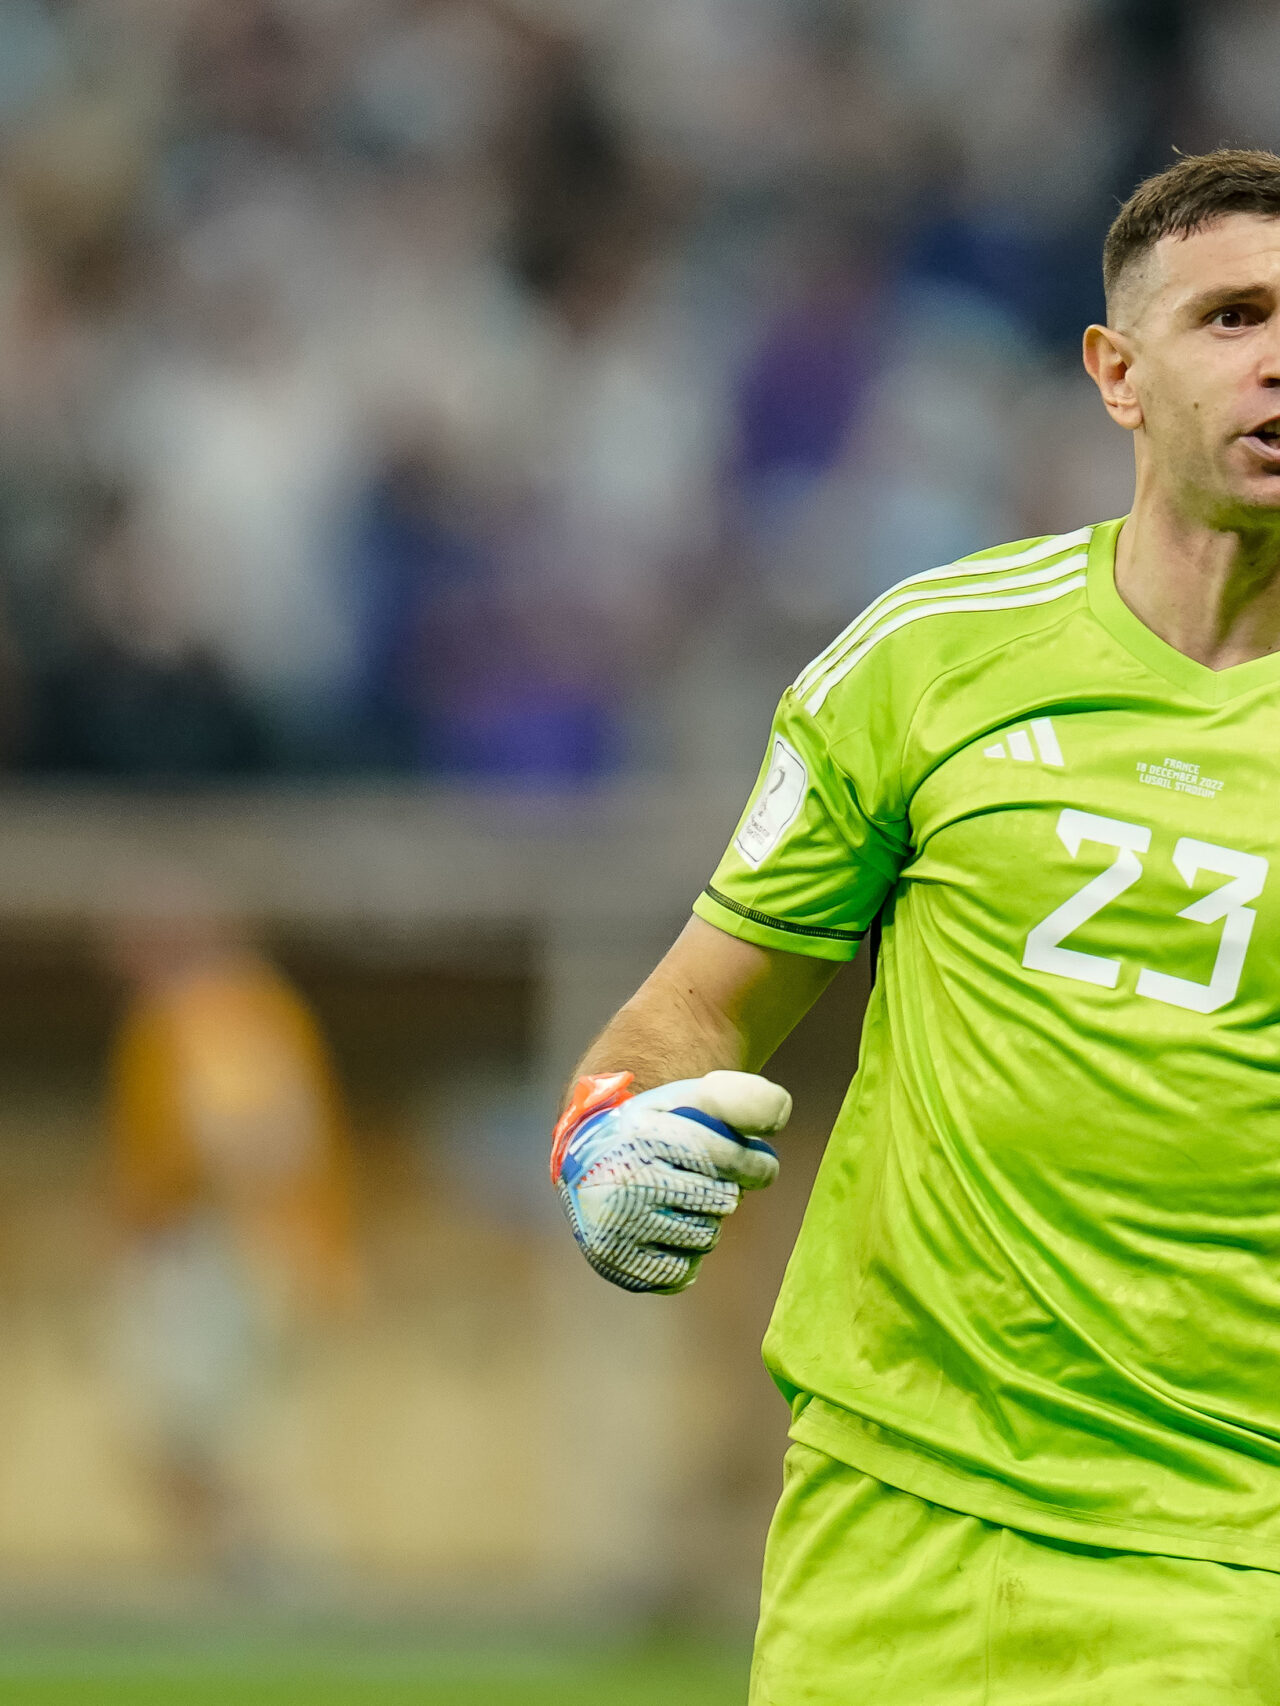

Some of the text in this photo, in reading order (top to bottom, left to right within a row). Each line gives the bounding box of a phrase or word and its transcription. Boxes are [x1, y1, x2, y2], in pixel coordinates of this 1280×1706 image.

[1149, 764, 1198, 784] DECEMBER
[1199, 777, 1224, 791] 2022
[1163, 758, 1200, 774] FRANCE
[1139, 773, 1216, 799] LUSAIL STADIUM
[1022, 808, 1269, 1014] 23
